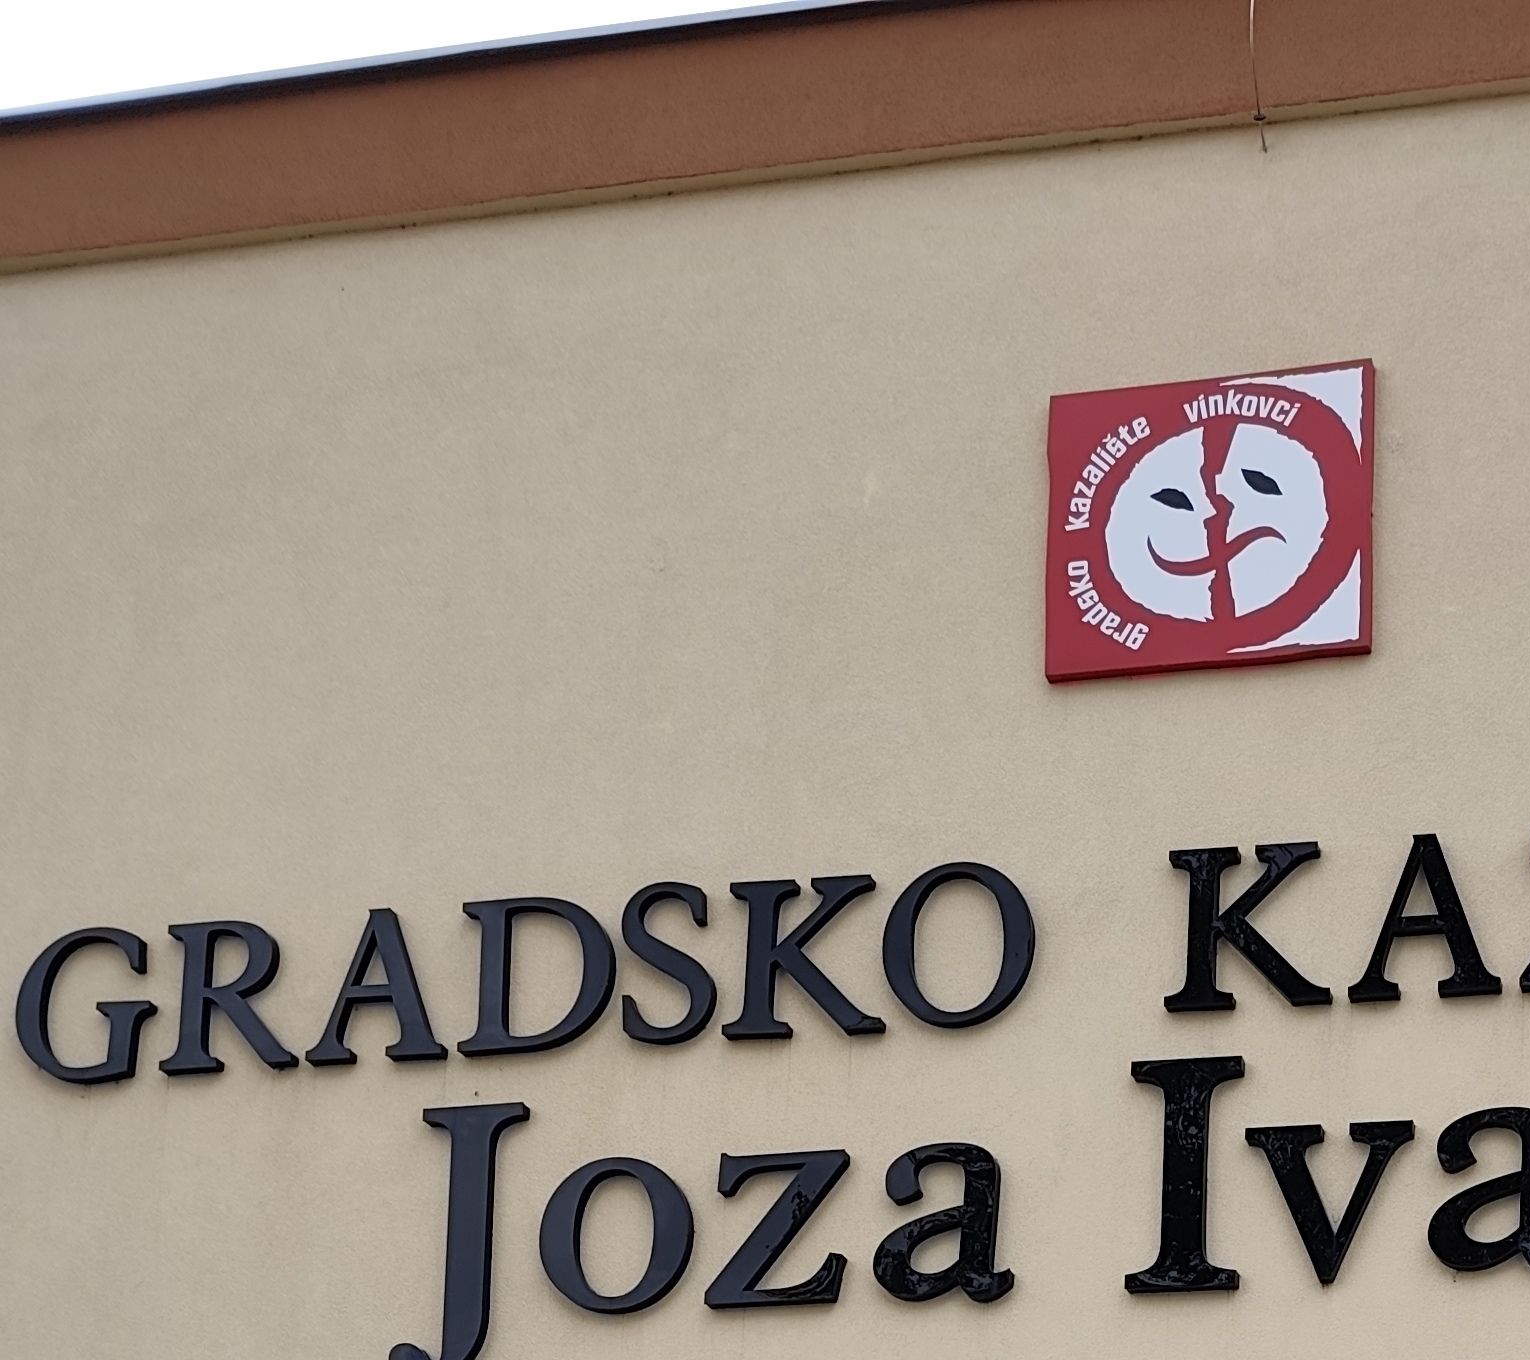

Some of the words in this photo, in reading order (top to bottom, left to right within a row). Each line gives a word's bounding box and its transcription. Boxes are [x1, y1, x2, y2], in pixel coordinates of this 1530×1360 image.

[1183, 389, 1301, 427] vinkovci
[1065, 416, 1151, 531] kazalište
[1067, 560, 1149, 650] gradsko
[15, 861, 1037, 1093] GRADSKO
